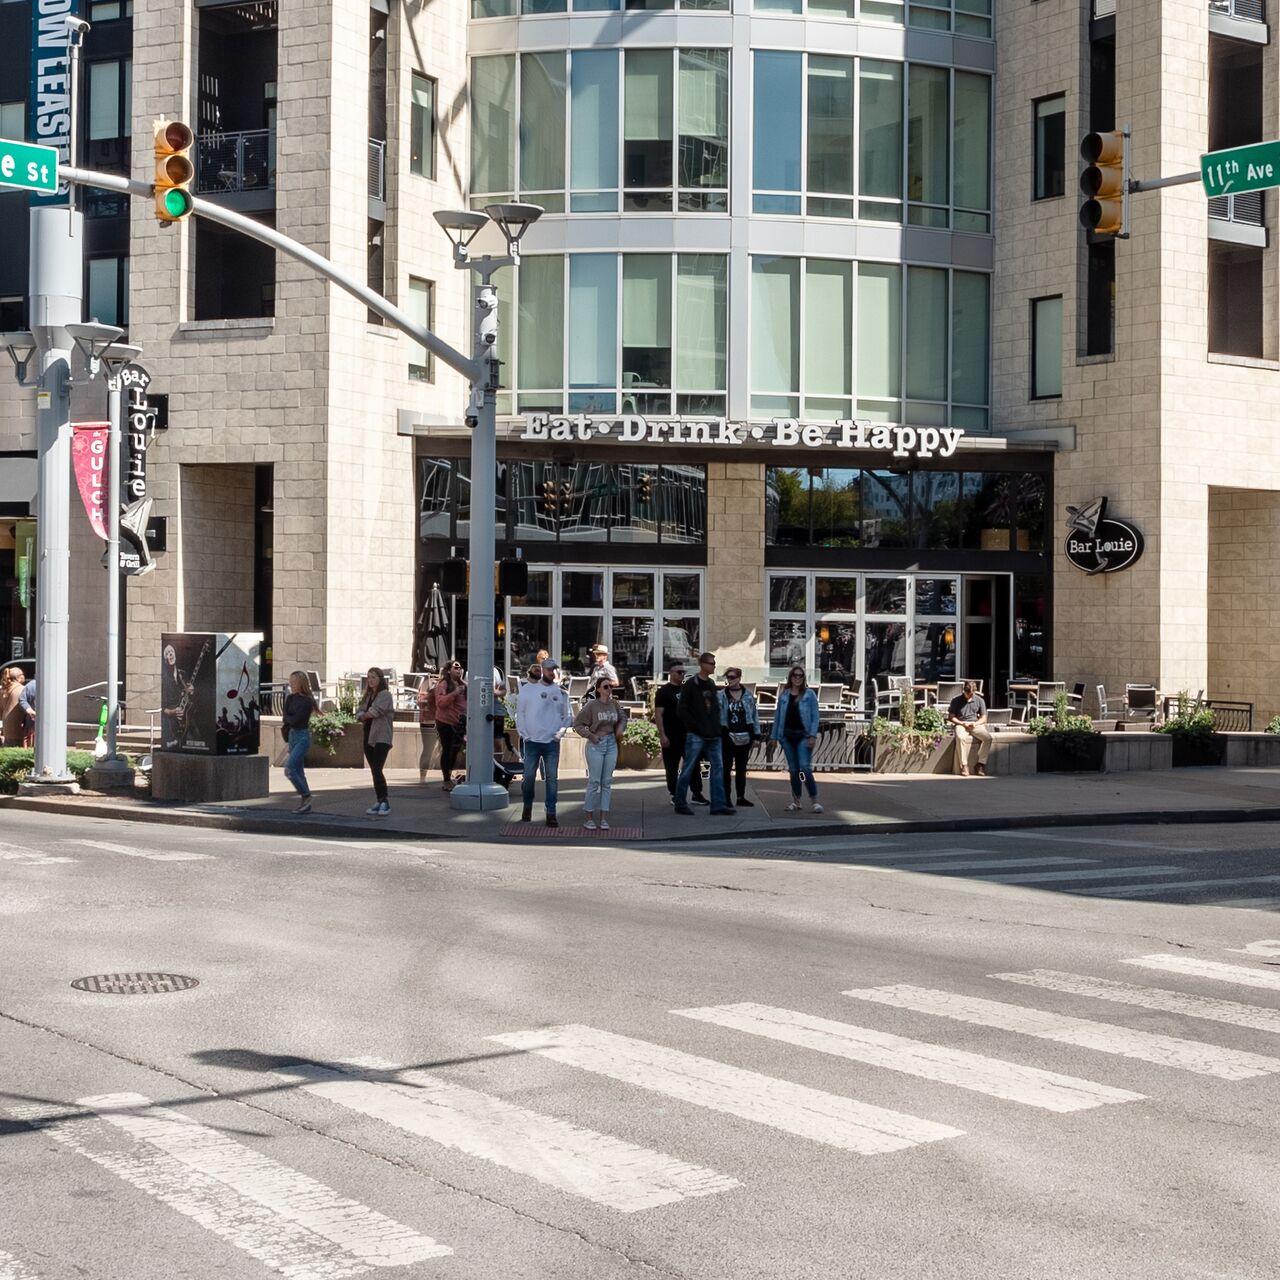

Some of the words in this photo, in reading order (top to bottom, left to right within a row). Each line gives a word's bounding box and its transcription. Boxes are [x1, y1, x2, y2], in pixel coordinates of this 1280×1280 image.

[27, 161, 49, 184] St
[1207, 159, 1240, 188] 11th
[1247, 163, 1274, 181] Ave
[121, 368, 149, 388] Bar
[132, 387, 148, 496] Louie
[520, 411, 593, 440] Eat
[617, 417, 743, 445] Drink
[772, 417, 823, 447] Be
[836, 420, 965, 458] Happy
[90, 440, 104, 521] GULCH
[1070, 539, 1093, 553] Bar
[1095, 538, 1133, 552] Louie
